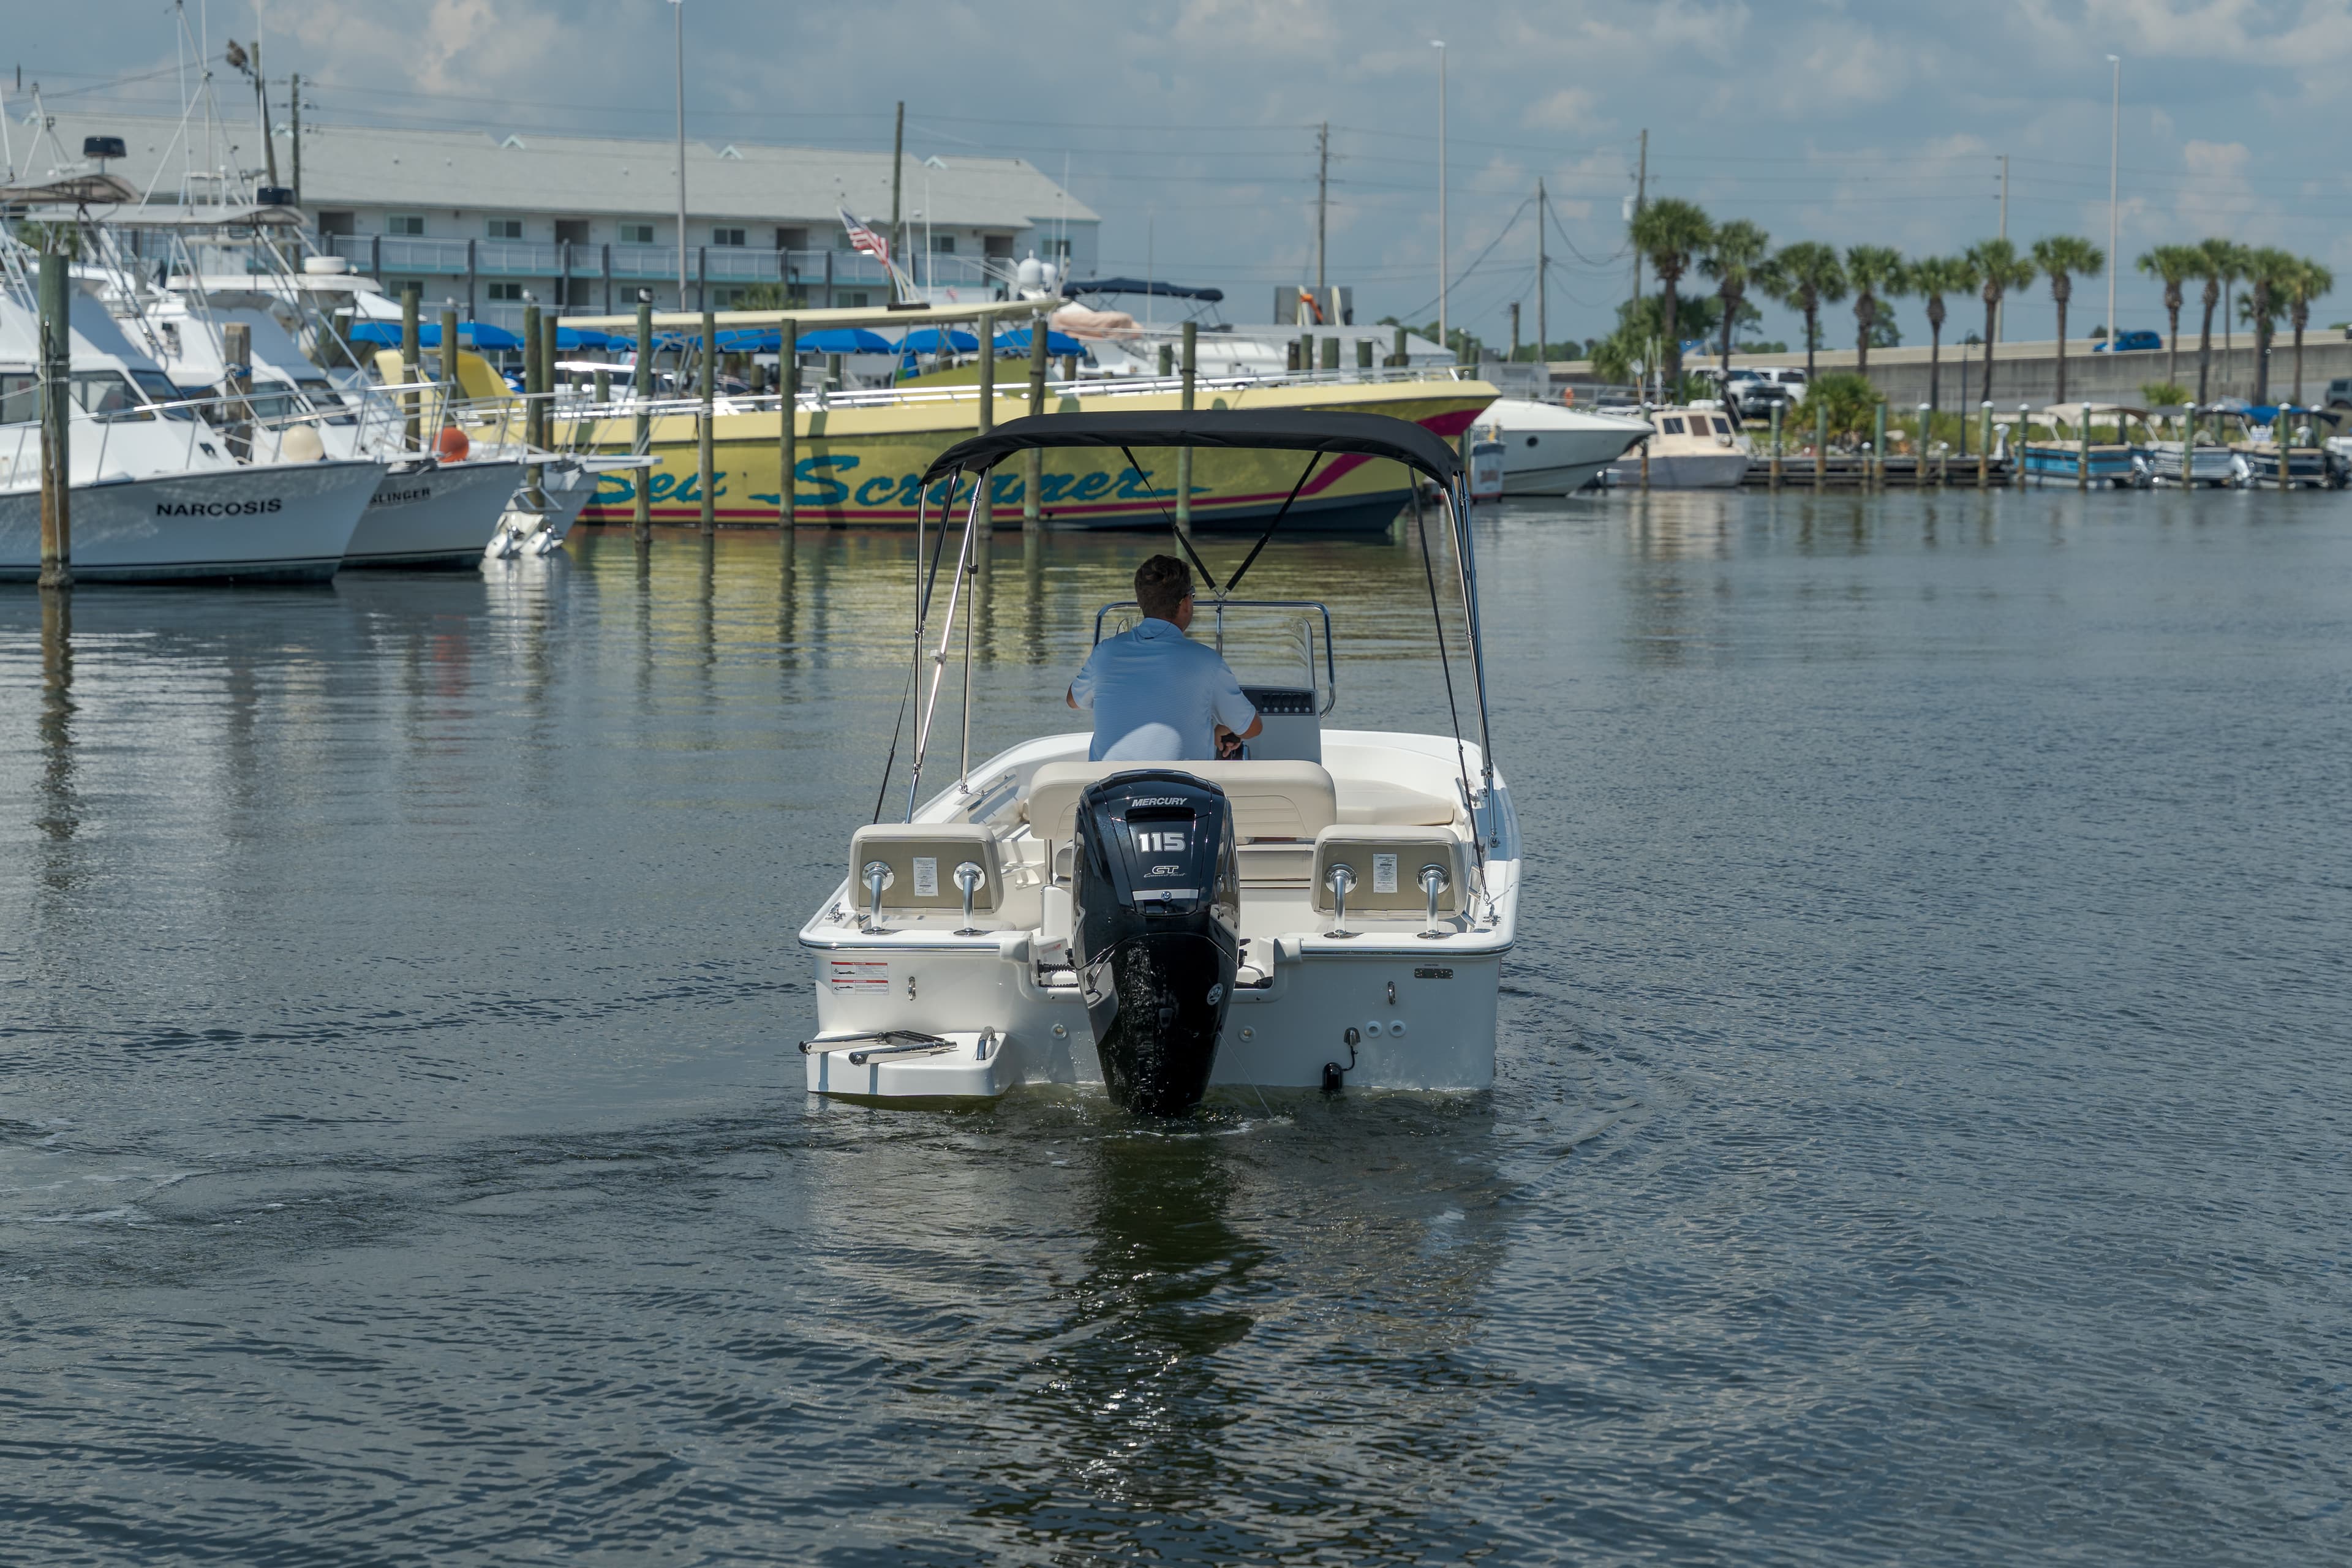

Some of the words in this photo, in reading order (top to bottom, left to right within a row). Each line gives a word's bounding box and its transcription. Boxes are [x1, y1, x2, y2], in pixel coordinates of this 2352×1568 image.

[156, 498, 282, 516] NARCOSIS
[1131, 797, 1188, 807] MERCURY
[1138, 832, 1186, 853] 115
